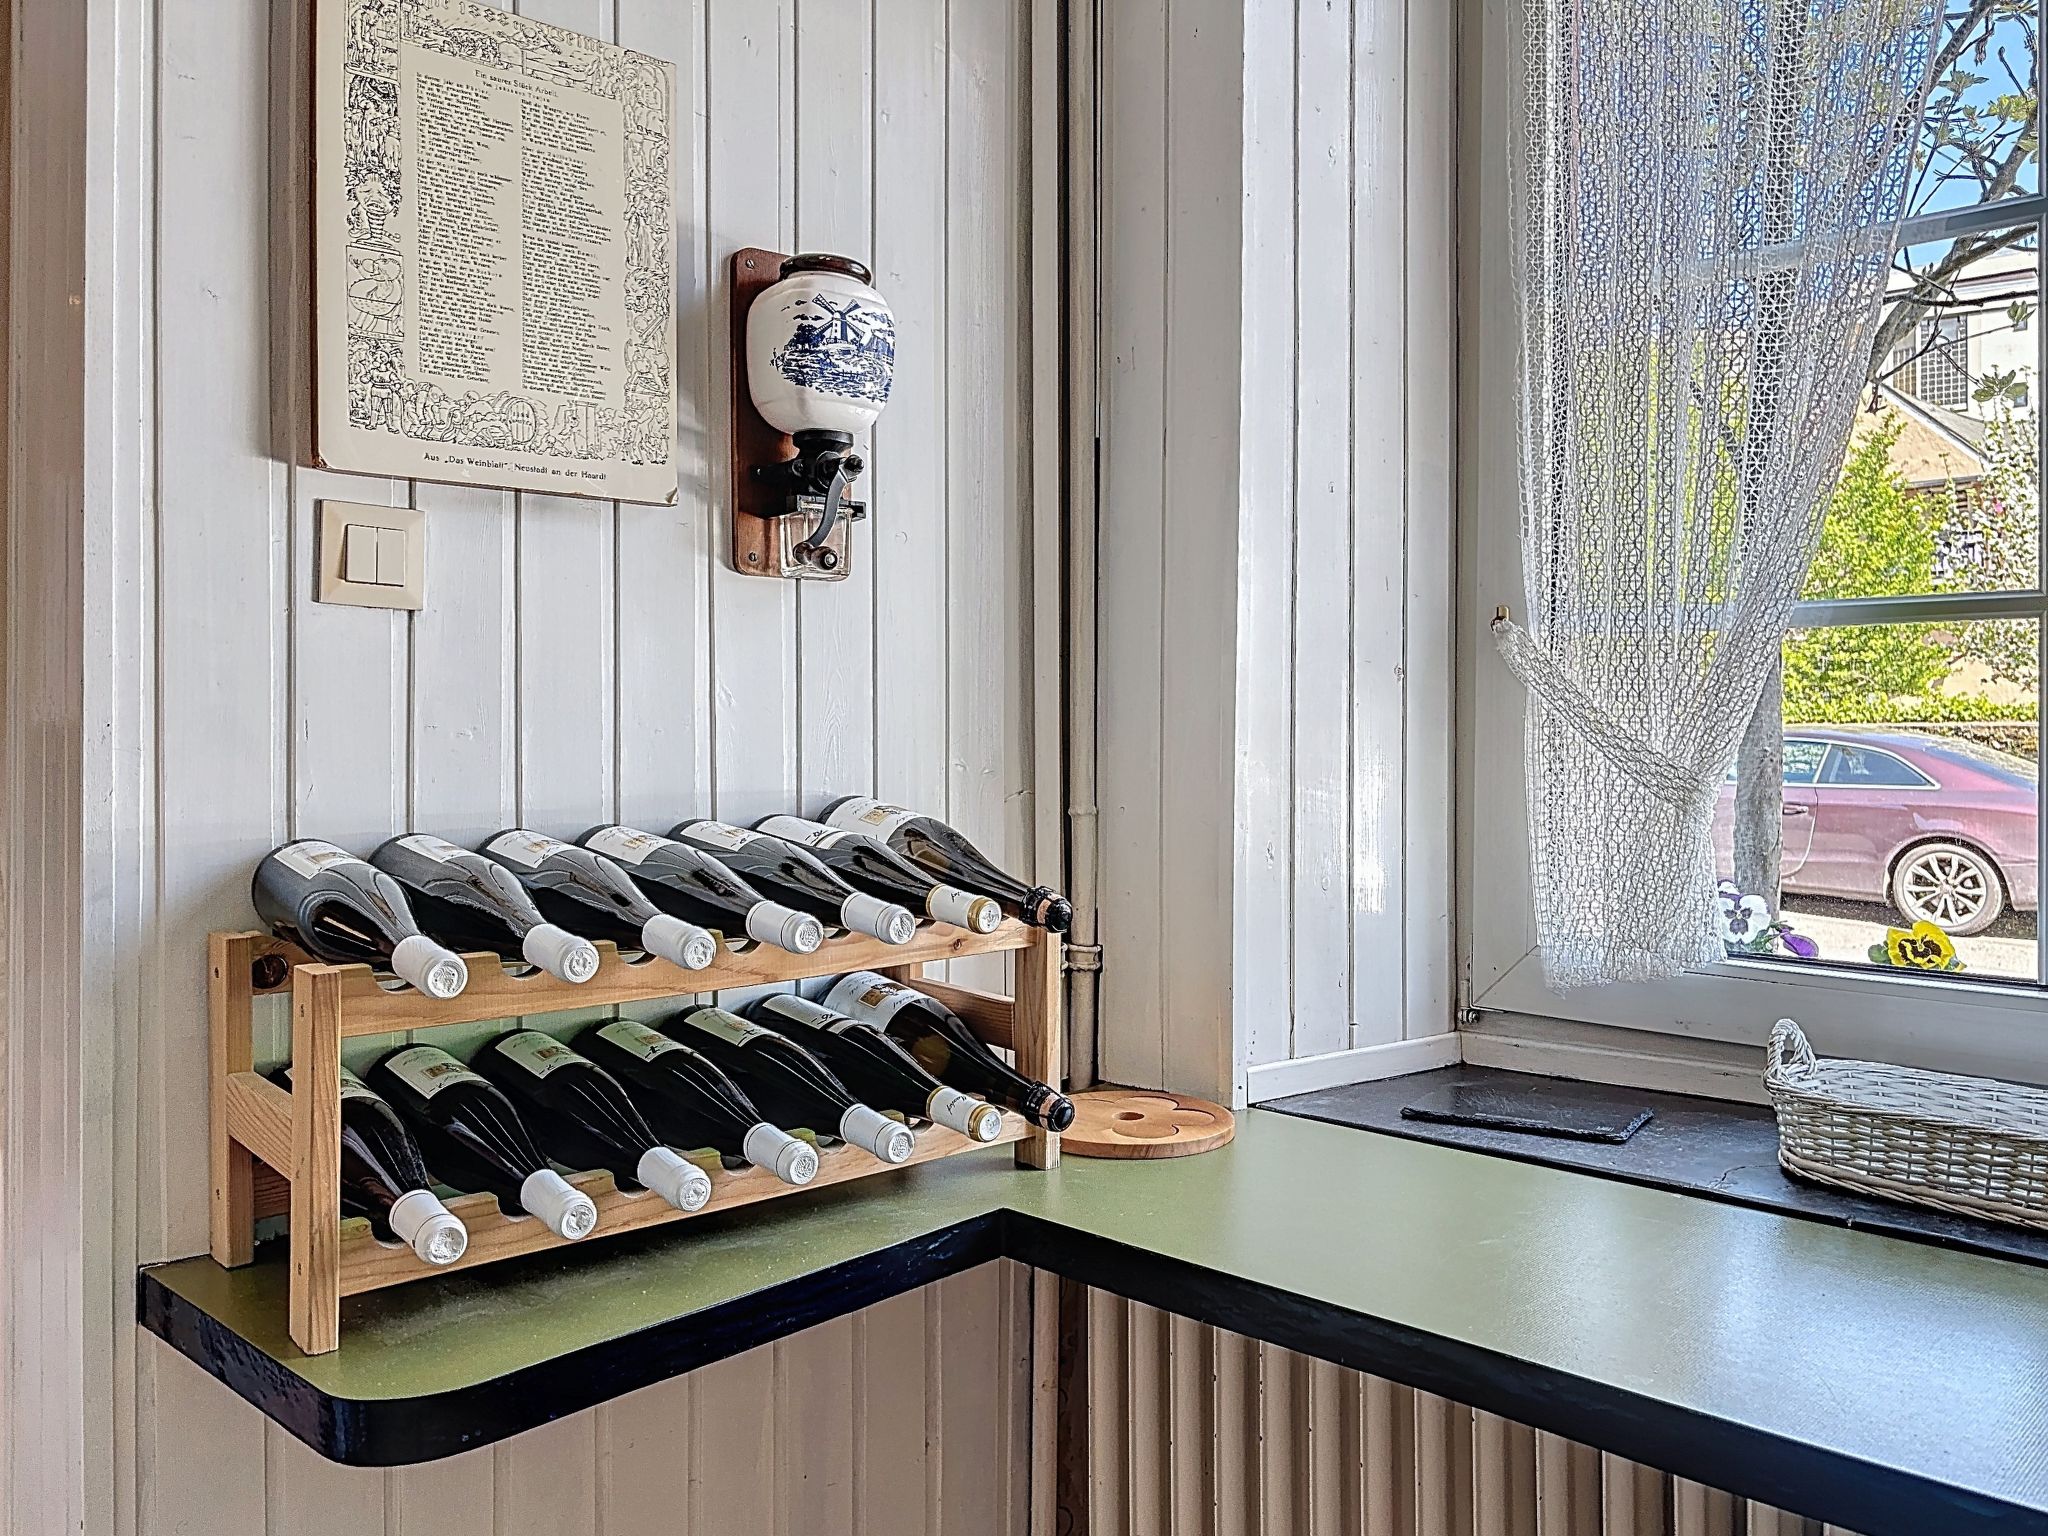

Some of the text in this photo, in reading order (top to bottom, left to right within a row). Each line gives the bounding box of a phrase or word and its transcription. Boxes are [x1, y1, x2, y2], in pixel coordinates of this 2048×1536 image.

[475, 69, 486, 79] Ein
[513, 79, 532, 91] Stück
[424, 452, 439, 462] Aus
[514, 463, 547, 474] Neustadt
[581, 471, 606, 480] Haardt
